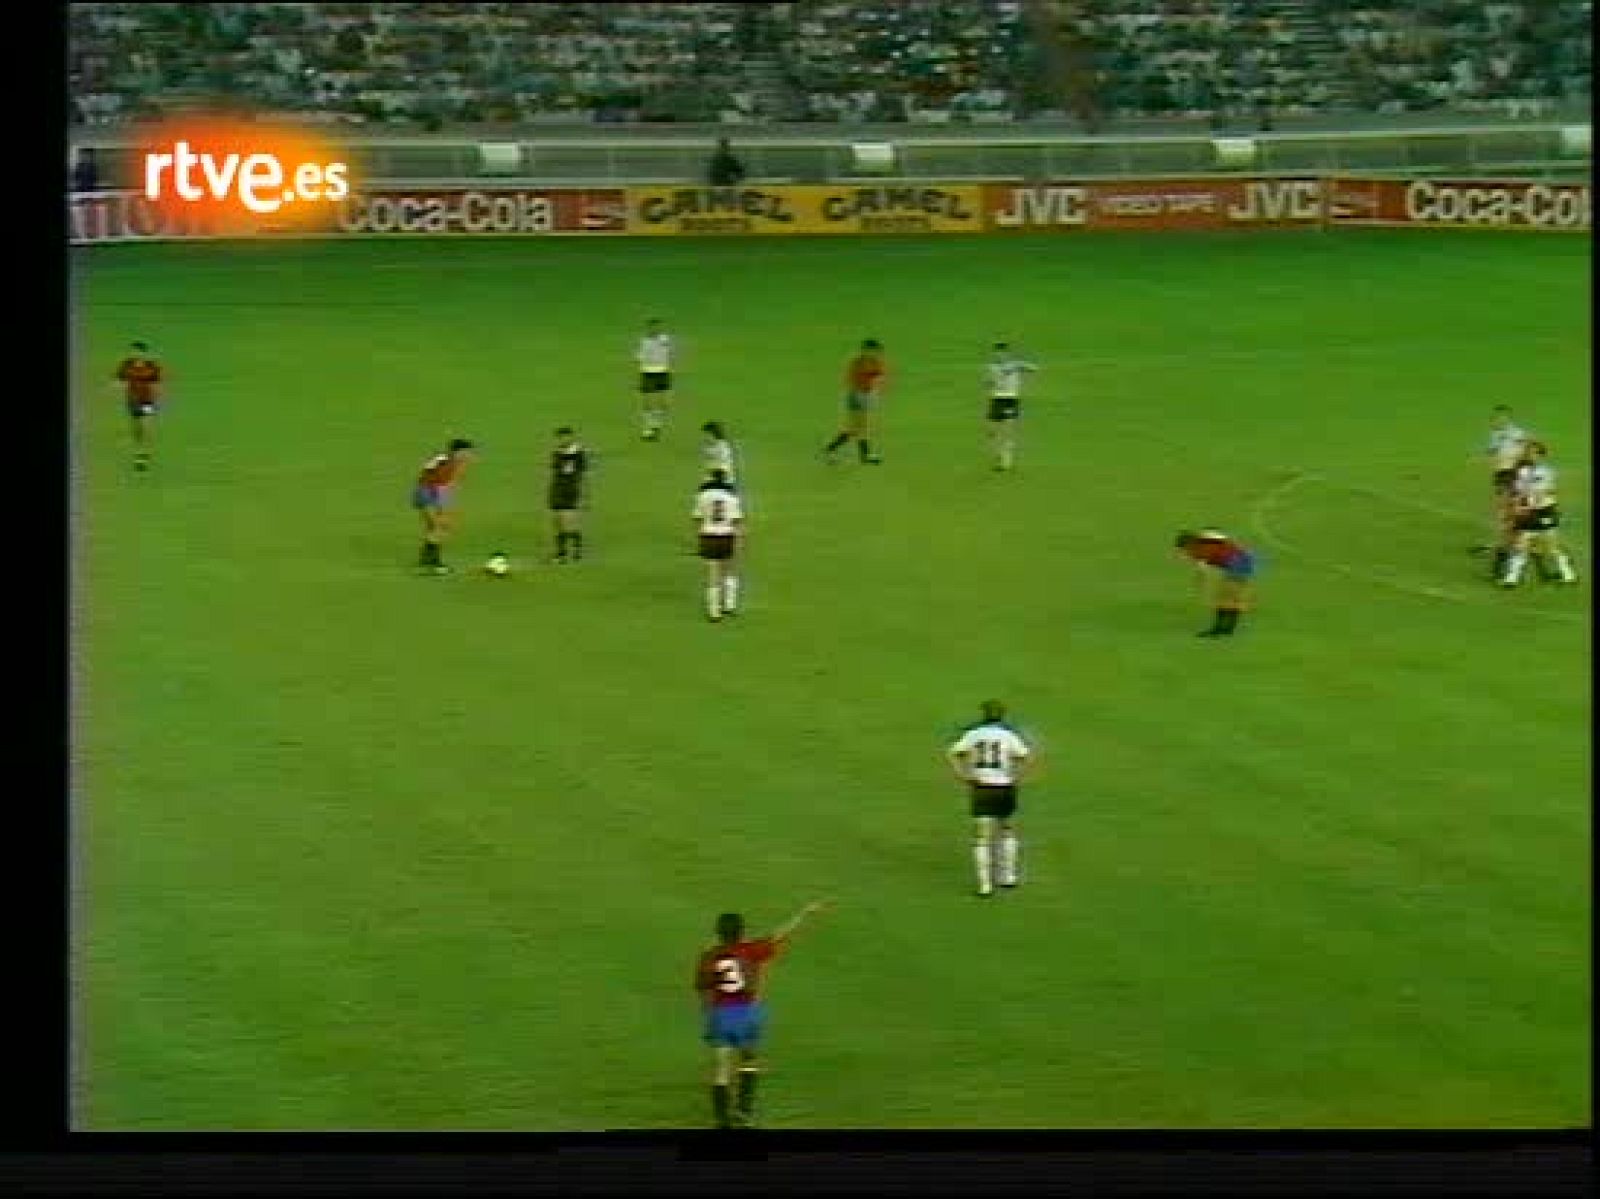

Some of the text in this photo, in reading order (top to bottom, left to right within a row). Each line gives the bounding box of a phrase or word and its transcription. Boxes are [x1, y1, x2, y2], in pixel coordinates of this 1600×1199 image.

[339, 190, 553, 232] Coca-Cola
[639, 188, 794, 224] CAMEL
[821, 187, 971, 223] CAMEL
[995, 187, 1087, 225] JVC
[1228, 182, 1321, 220] JVC
[975, 740, 1002, 769] 11
[715, 959, 745, 993] 3
